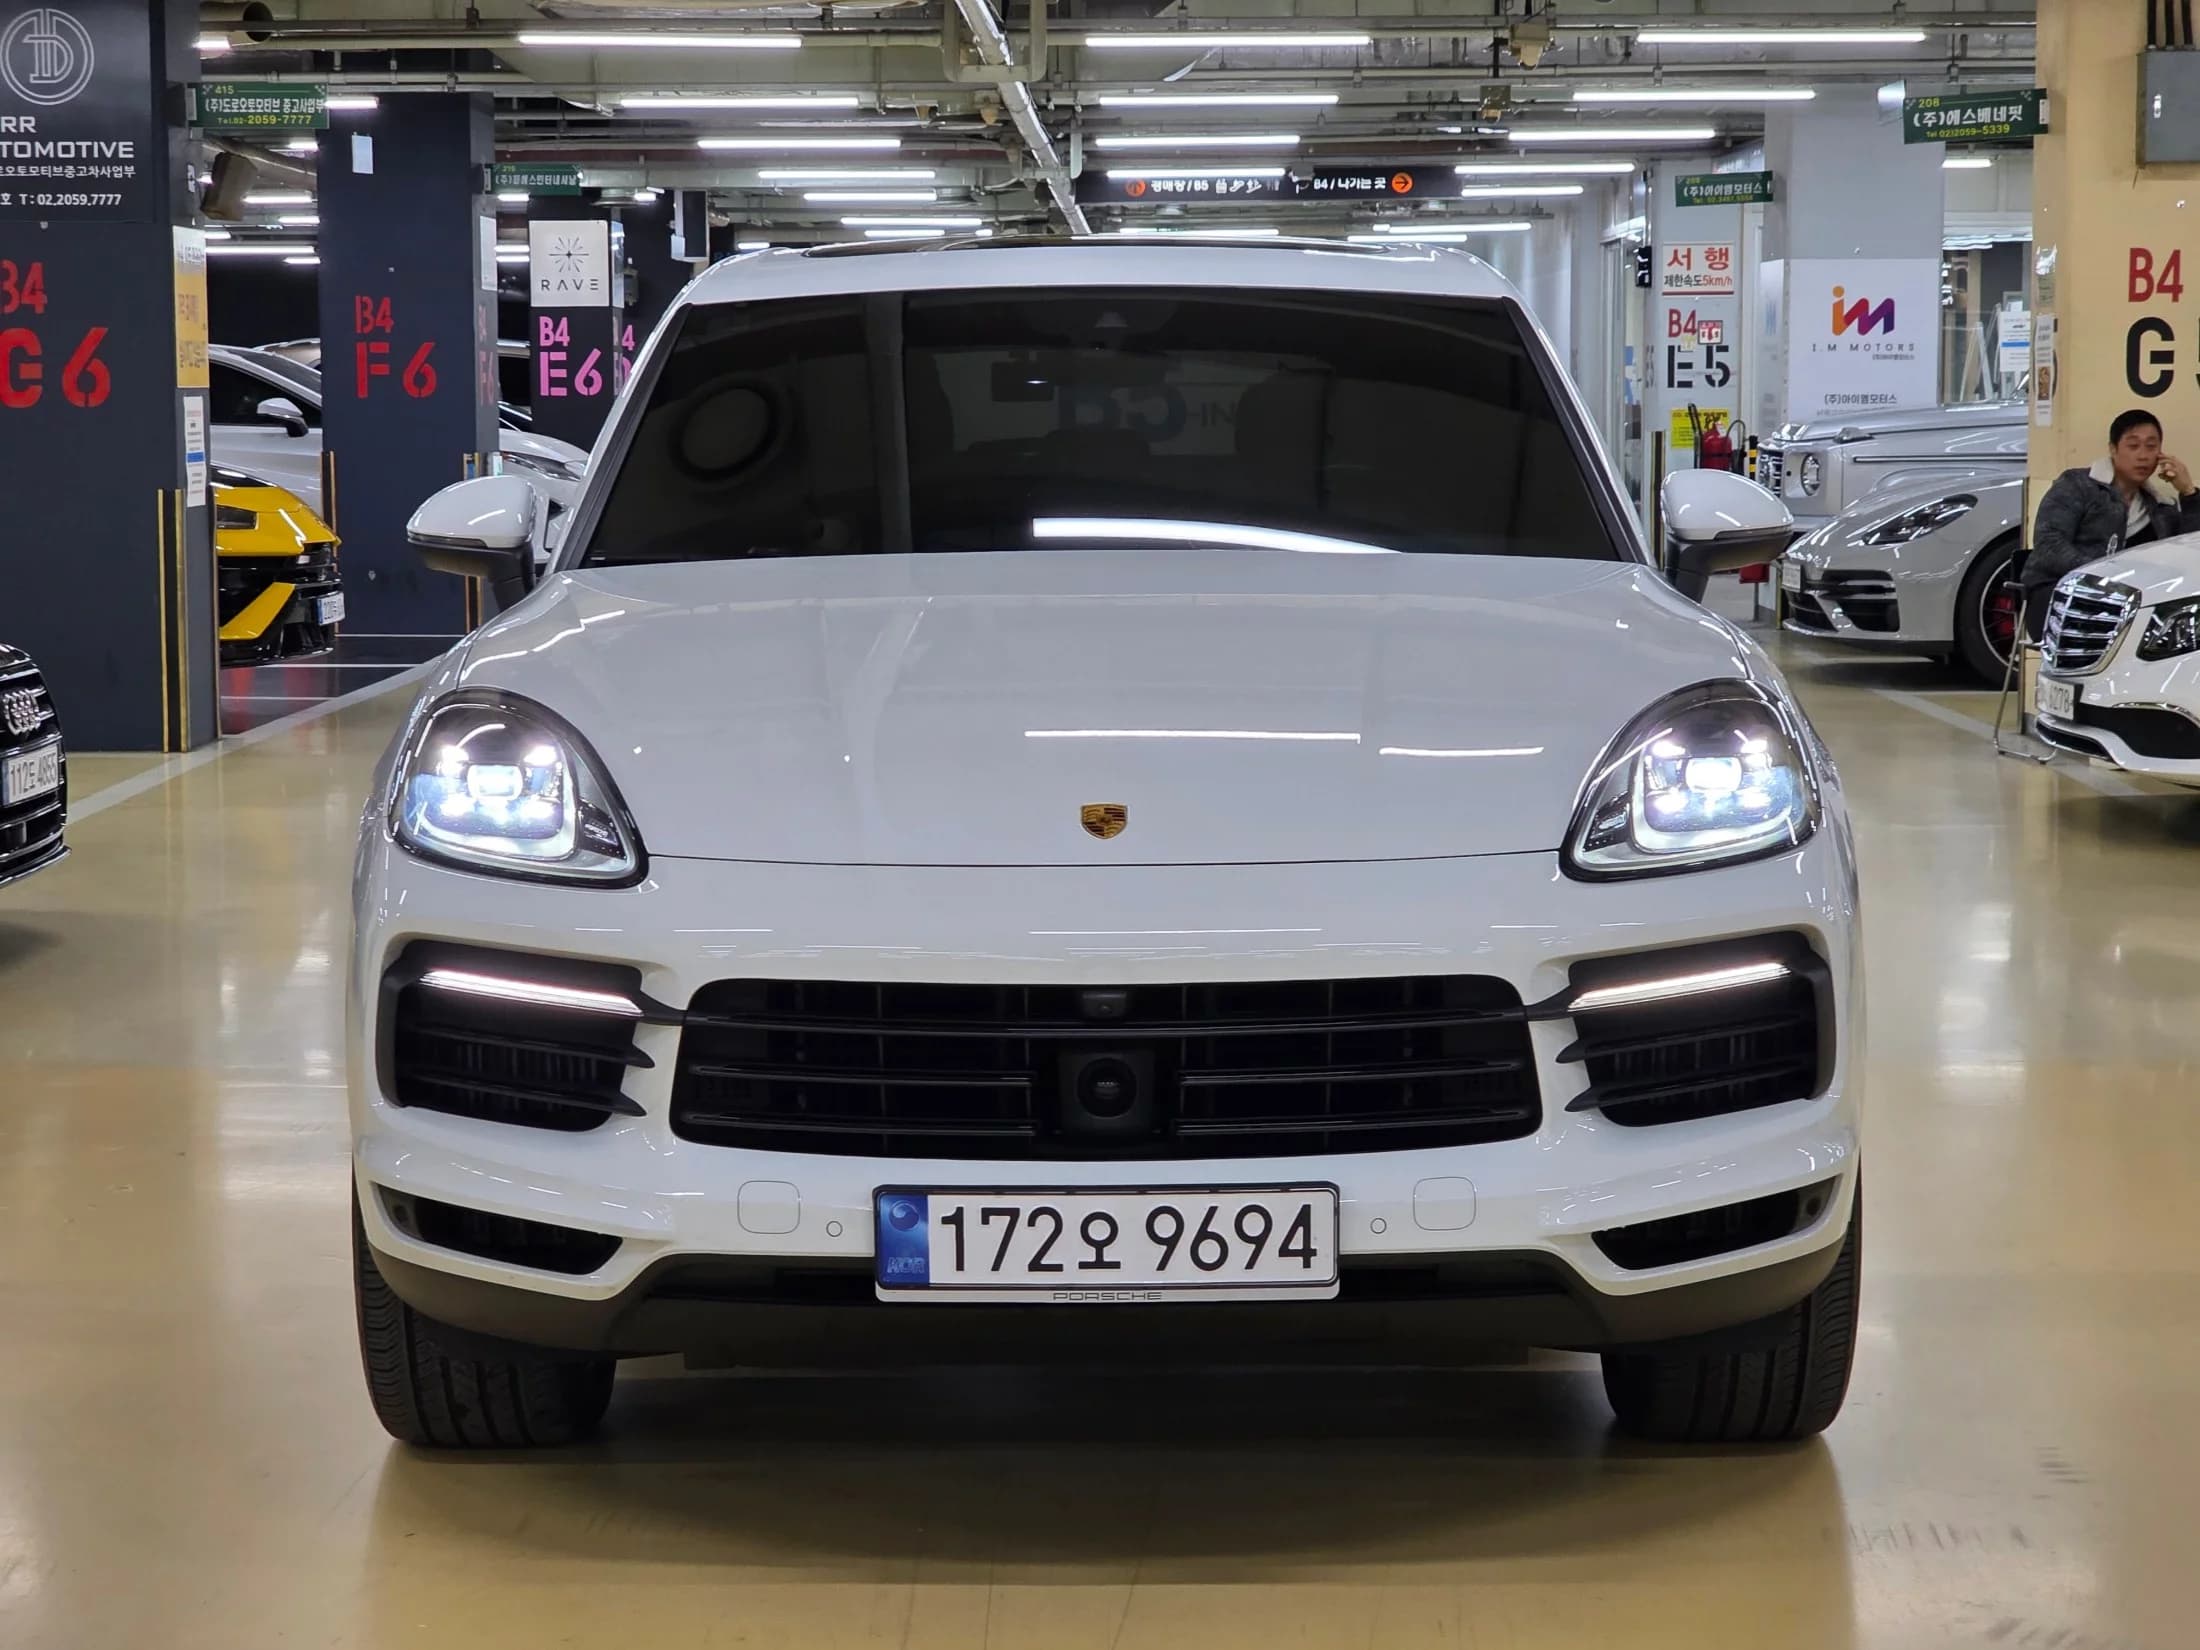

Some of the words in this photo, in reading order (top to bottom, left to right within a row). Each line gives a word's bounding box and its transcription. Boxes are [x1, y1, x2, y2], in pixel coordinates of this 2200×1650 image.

[215, 85, 235, 95] 415
[1918, 98, 1940, 108] 208
[0, 116, 37, 133] RR
[0, 141, 135, 159] TOMOTIVE
[2128, 247, 2184, 303] B4
[541, 279, 599, 291] RAVE
[355, 295, 395, 334] B4
[1668, 308, 1697, 338] B4
[539, 316, 571, 347] B4
[1849, 343, 1915, 352] MOTORS
[940, 1206, 1121, 1272] 172오
[1144, 1203, 1318, 1271] 9694
[1053, 1292, 1162, 1300] PORSCHE
